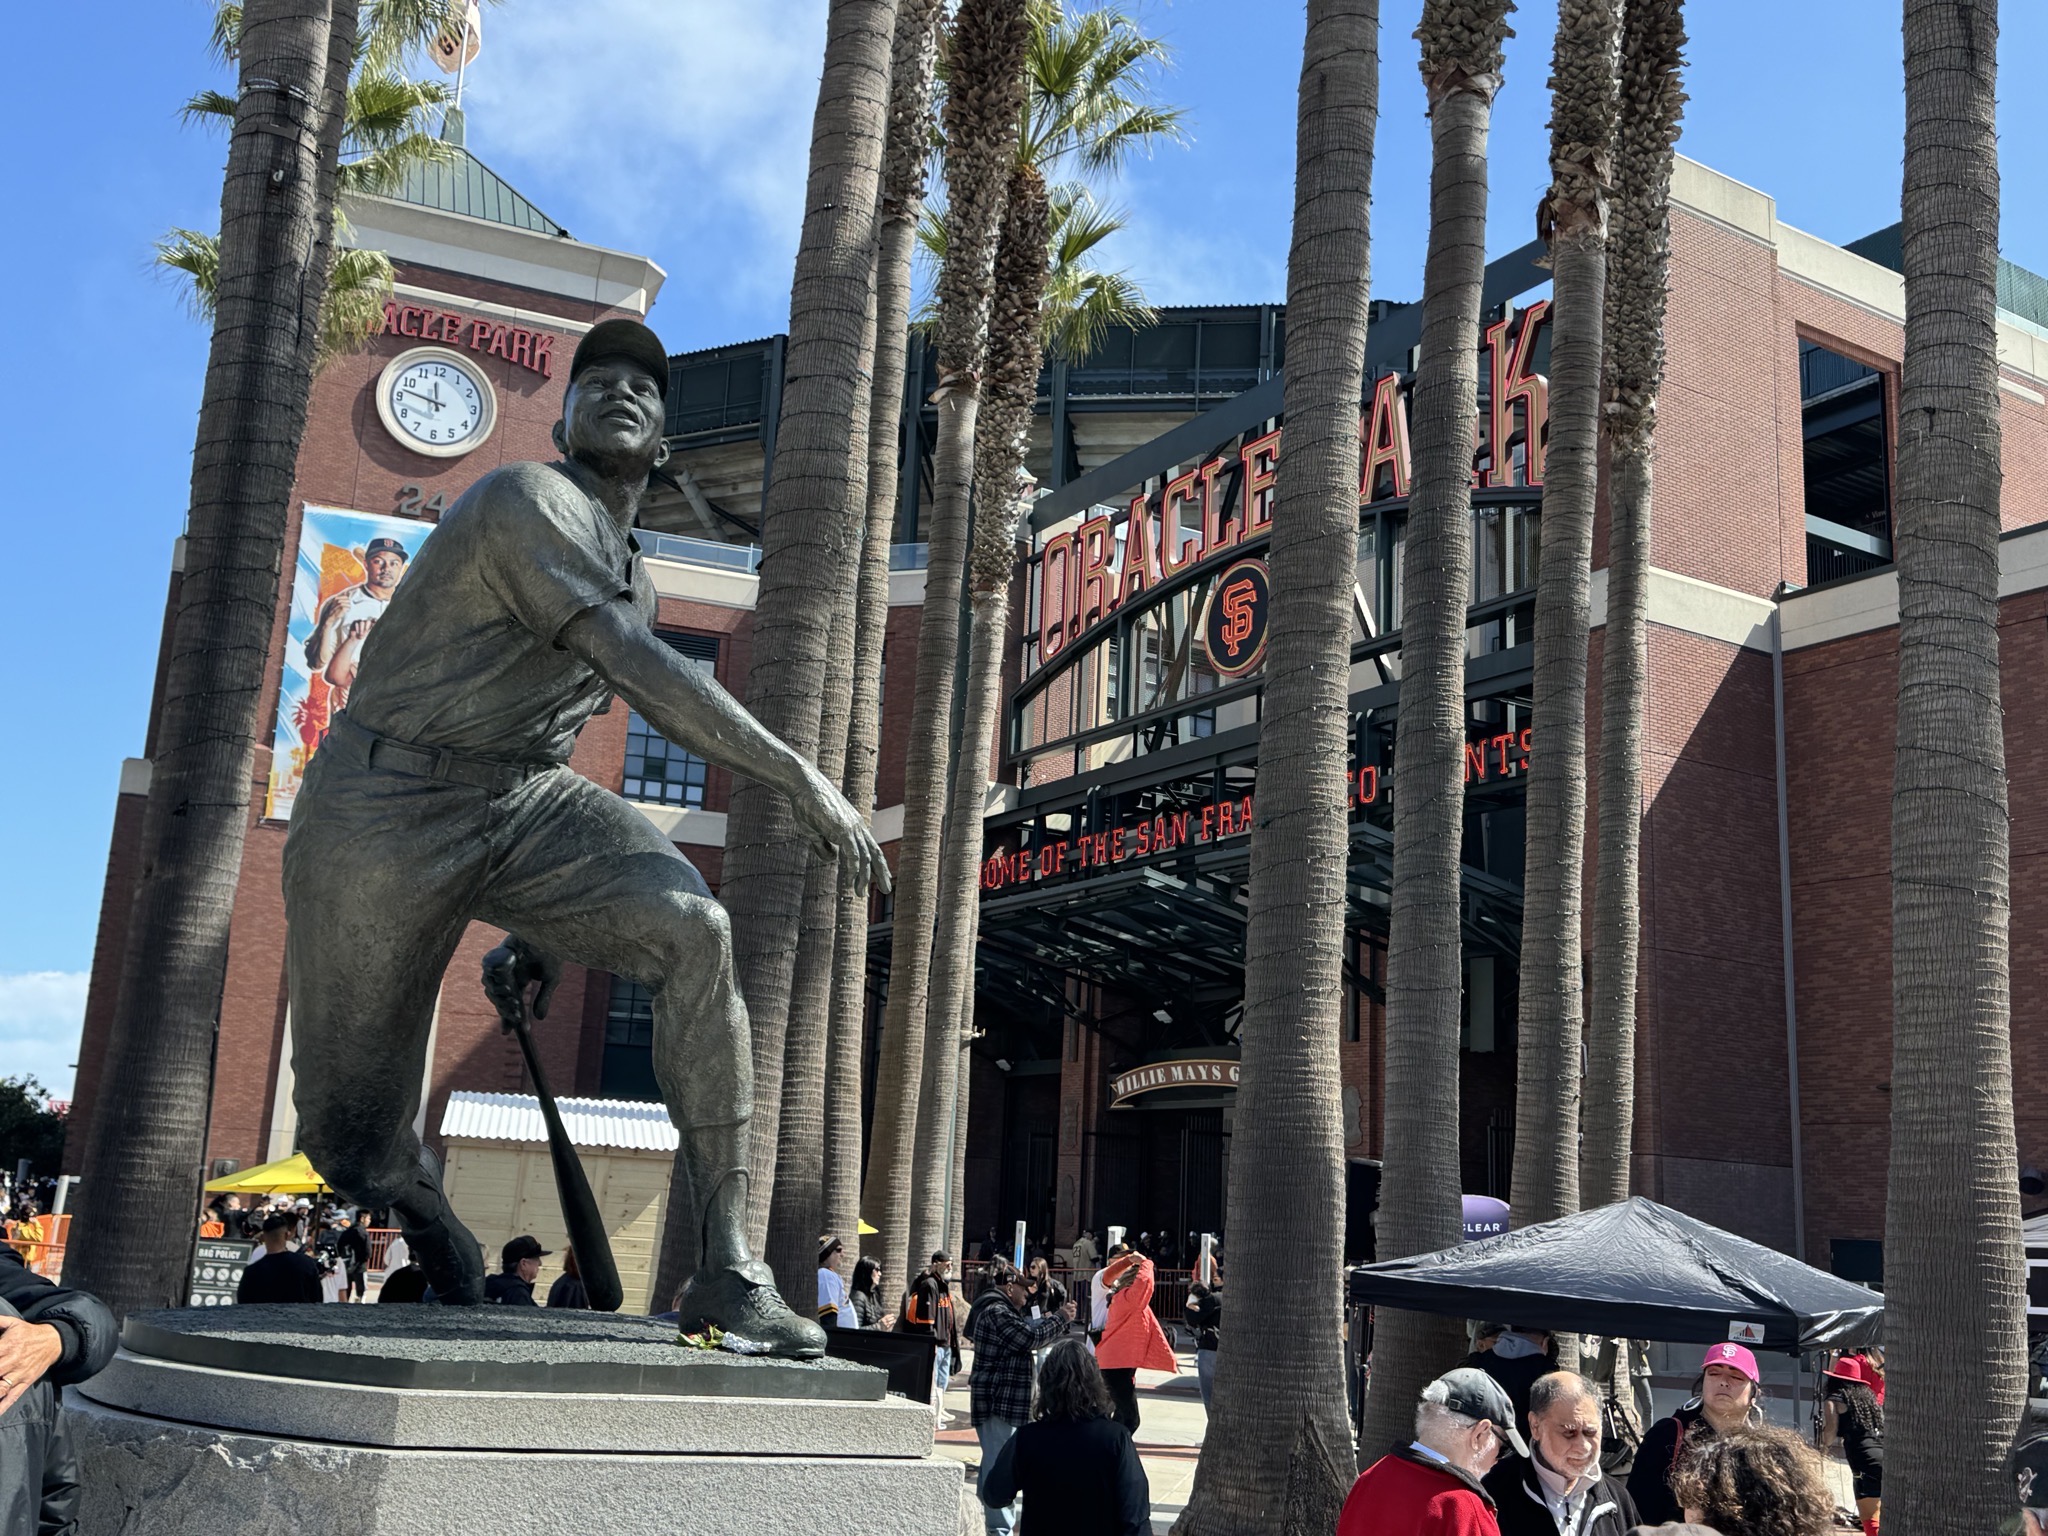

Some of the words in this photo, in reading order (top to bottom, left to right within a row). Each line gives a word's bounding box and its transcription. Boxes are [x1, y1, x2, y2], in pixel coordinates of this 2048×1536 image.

[367, 302, 461, 344] ACLE
[470, 320, 554, 379] PARK
[418, 368, 428, 379] 11
[434, 367, 446, 378] 12
[403, 377, 416, 388] 10
[455, 375, 460, 385] 1
[396, 391, 403, 401] 9
[466, 388, 473, 398] 2
[400, 408, 408, 418] 8
[470, 405, 477, 415] 3
[413, 421, 421, 431] 7
[461, 420, 469, 430] 4
[430, 430, 437, 440] 6
[448, 428, 455, 438] 5
[400, 483, 447, 520] 24
[1038, 428, 1284, 665] ORACLE
[1222, 579, 1257, 657] SF
[1040, 841, 1068, 877] OF
[1078, 827, 1125, 868] THE
[1136, 809, 1190, 855] SAN
[1116, 1066, 1166, 1096] WILLIE
[1171, 1064, 1222, 1082] MAYS
[198, 1248, 214, 1258] BAG
[215, 1249, 241, 1260] POLICY
[1722, 1344, 1738, 1359] SF
